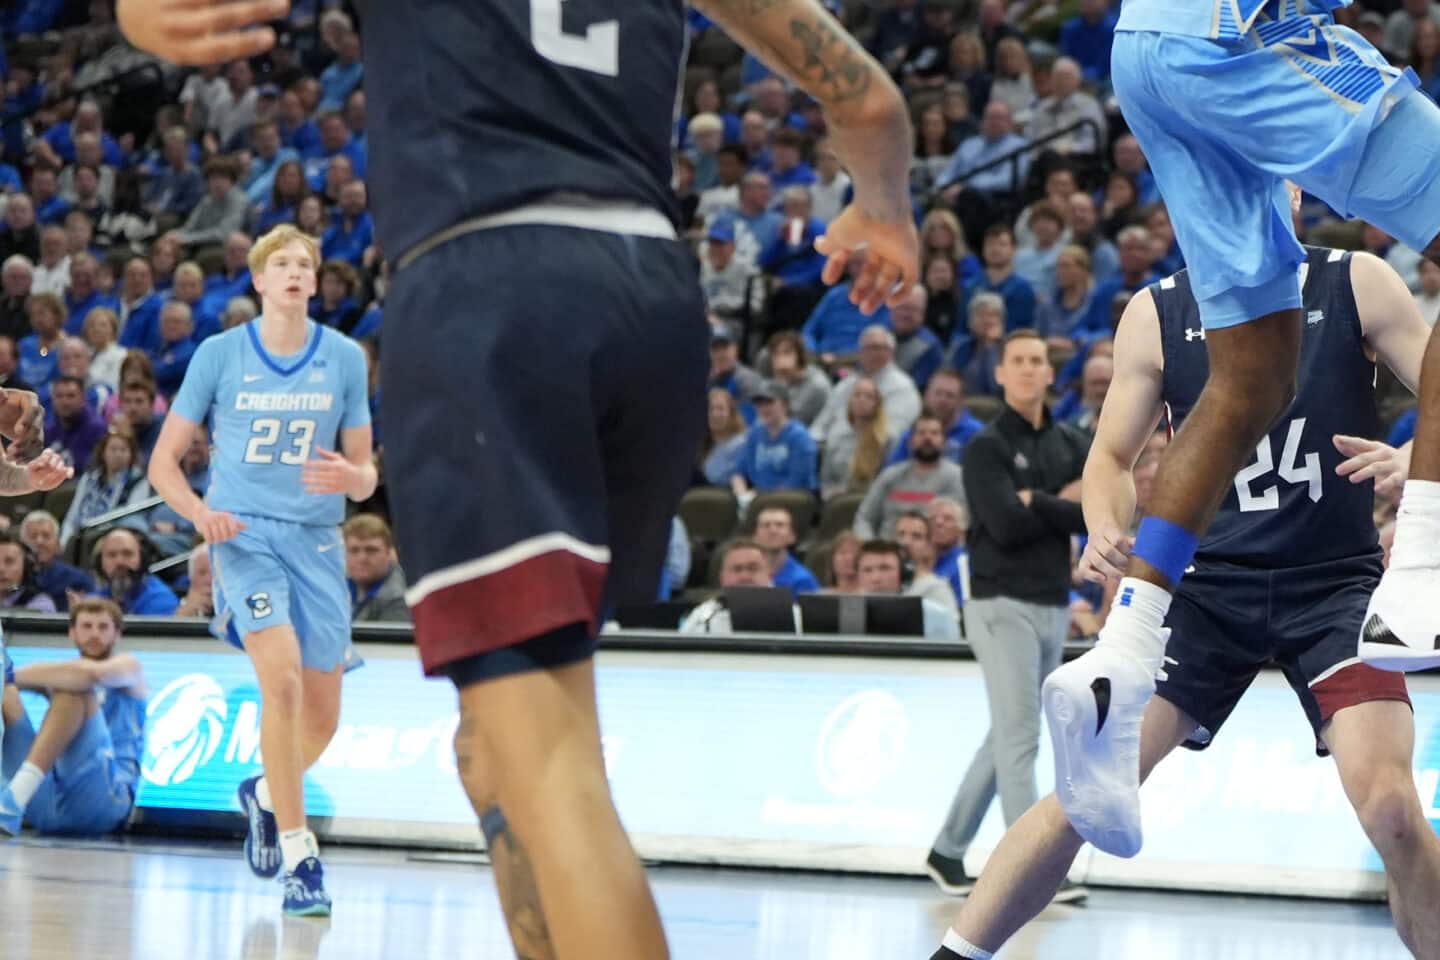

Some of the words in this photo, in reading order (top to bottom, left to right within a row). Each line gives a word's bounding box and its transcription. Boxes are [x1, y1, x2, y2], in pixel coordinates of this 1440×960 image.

[234, 391, 334, 411] CREIGHTON
[242, 419, 316, 465] 23
[1233, 417, 1323, 512] 24
